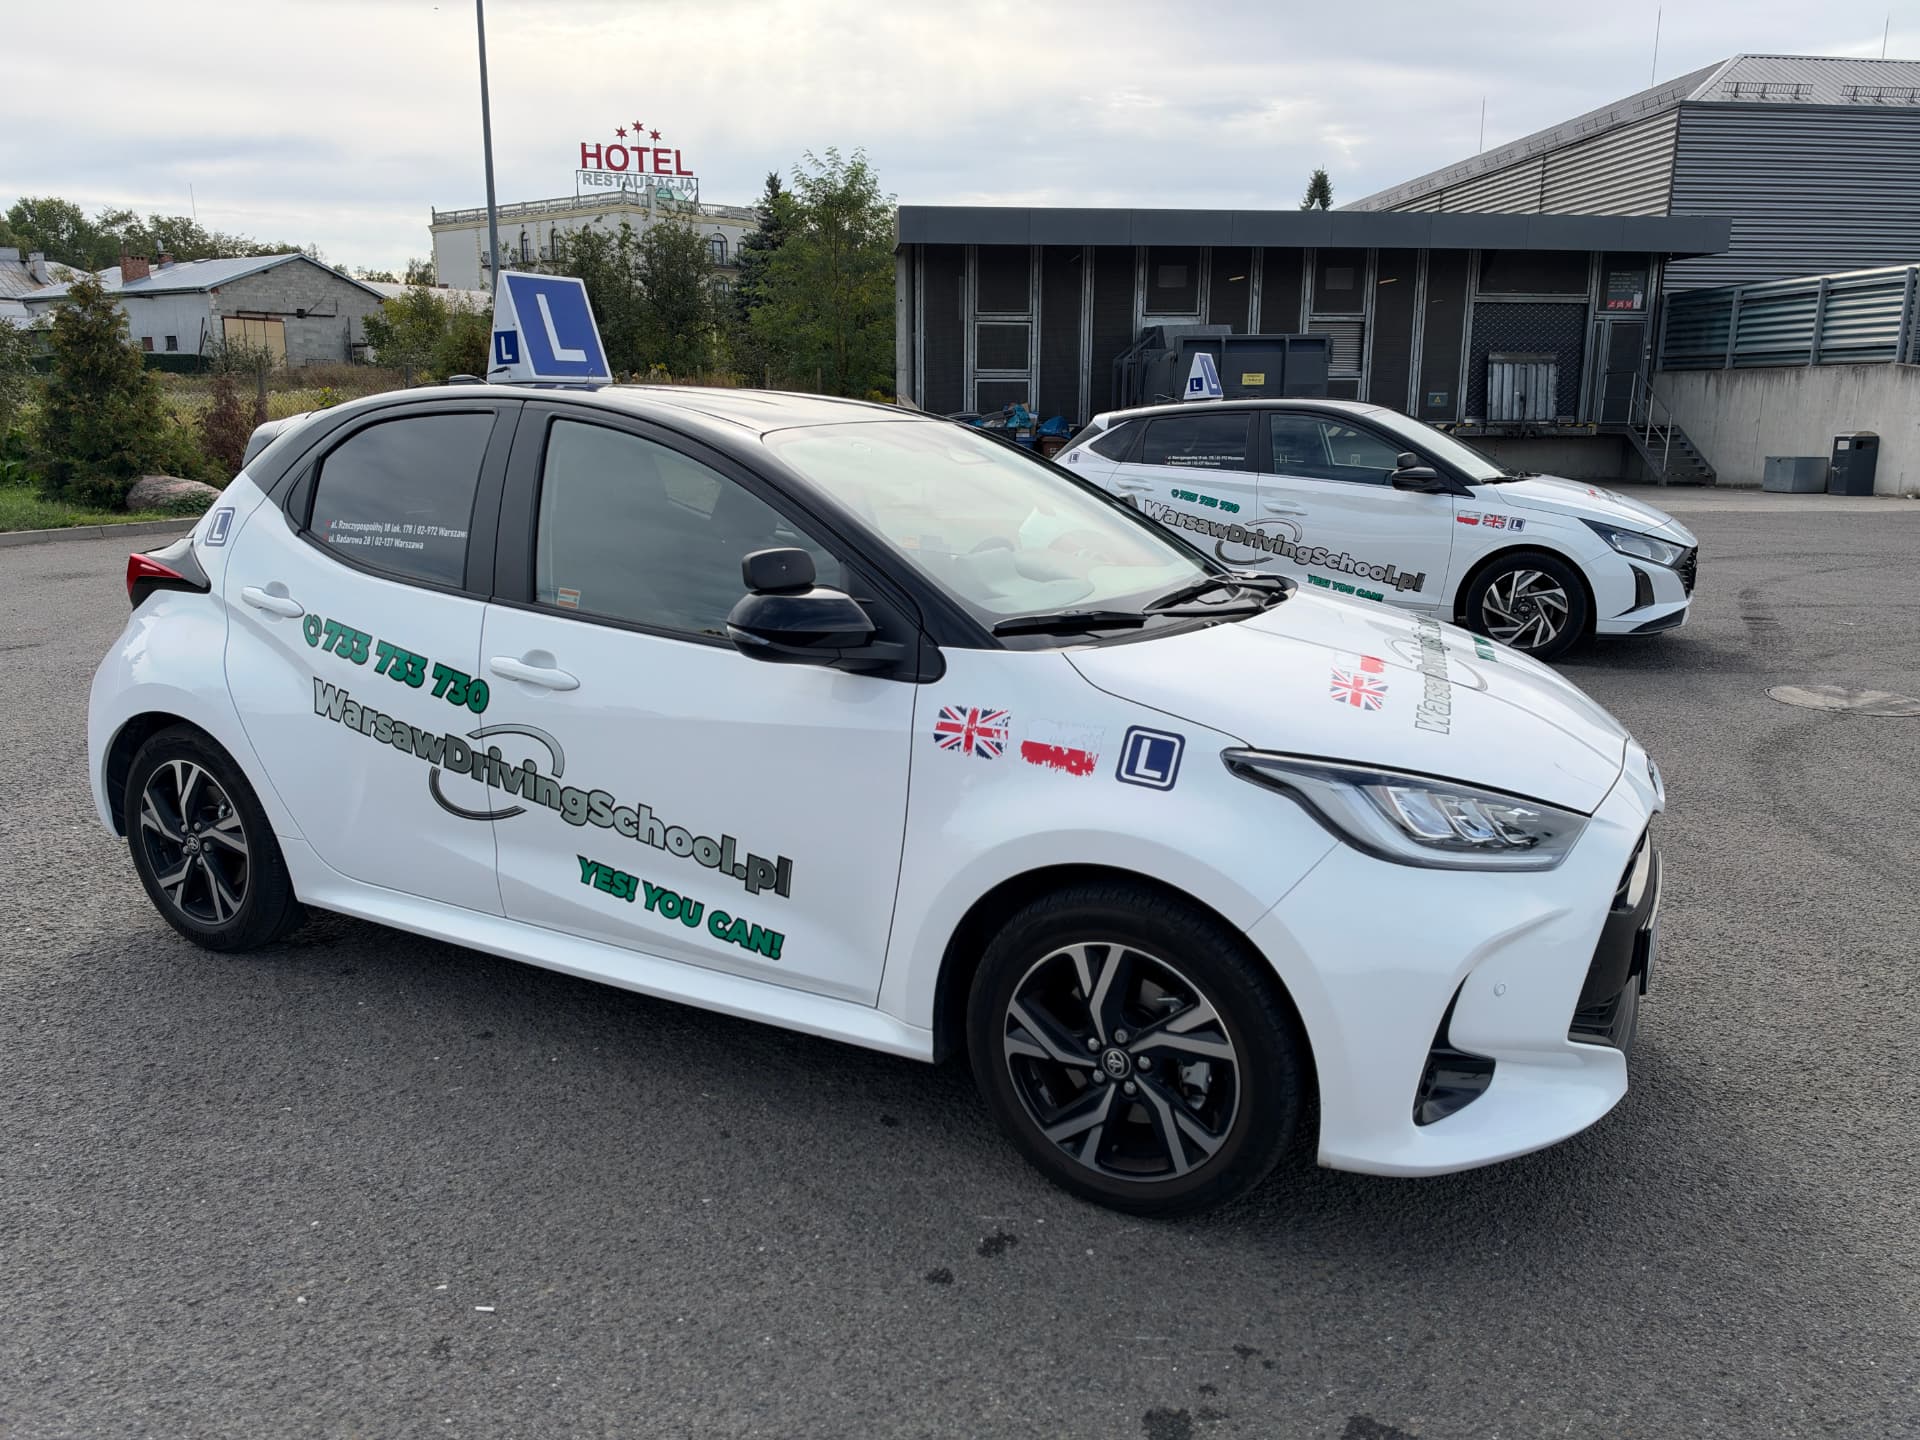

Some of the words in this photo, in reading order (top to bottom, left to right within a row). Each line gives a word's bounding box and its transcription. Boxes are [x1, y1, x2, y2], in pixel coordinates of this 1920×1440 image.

[580, 142, 694, 176] HOTEL
[535, 293, 588, 362] L
[500, 336, 513, 360] L
[1193, 379, 1200, 390] L
[1203, 361, 1218, 389] L
[212, 514, 224, 539] L
[394, 538, 424, 550] Warszawa
[1144, 499, 1426, 592] WarsawDrivingSchool.pl
[1332, 581, 1355, 594] YOU
[321, 618, 373, 665] 733
[374, 639, 428, 688] 733
[431, 662, 490, 714] 730
[1135, 738, 1162, 779] L
[313, 676, 793, 898] WarsawDrivingSchool.pl
[577, 854, 640, 903] YES!
[642, 880, 705, 928] YOU
[707, 910, 785, 960] CAN!
